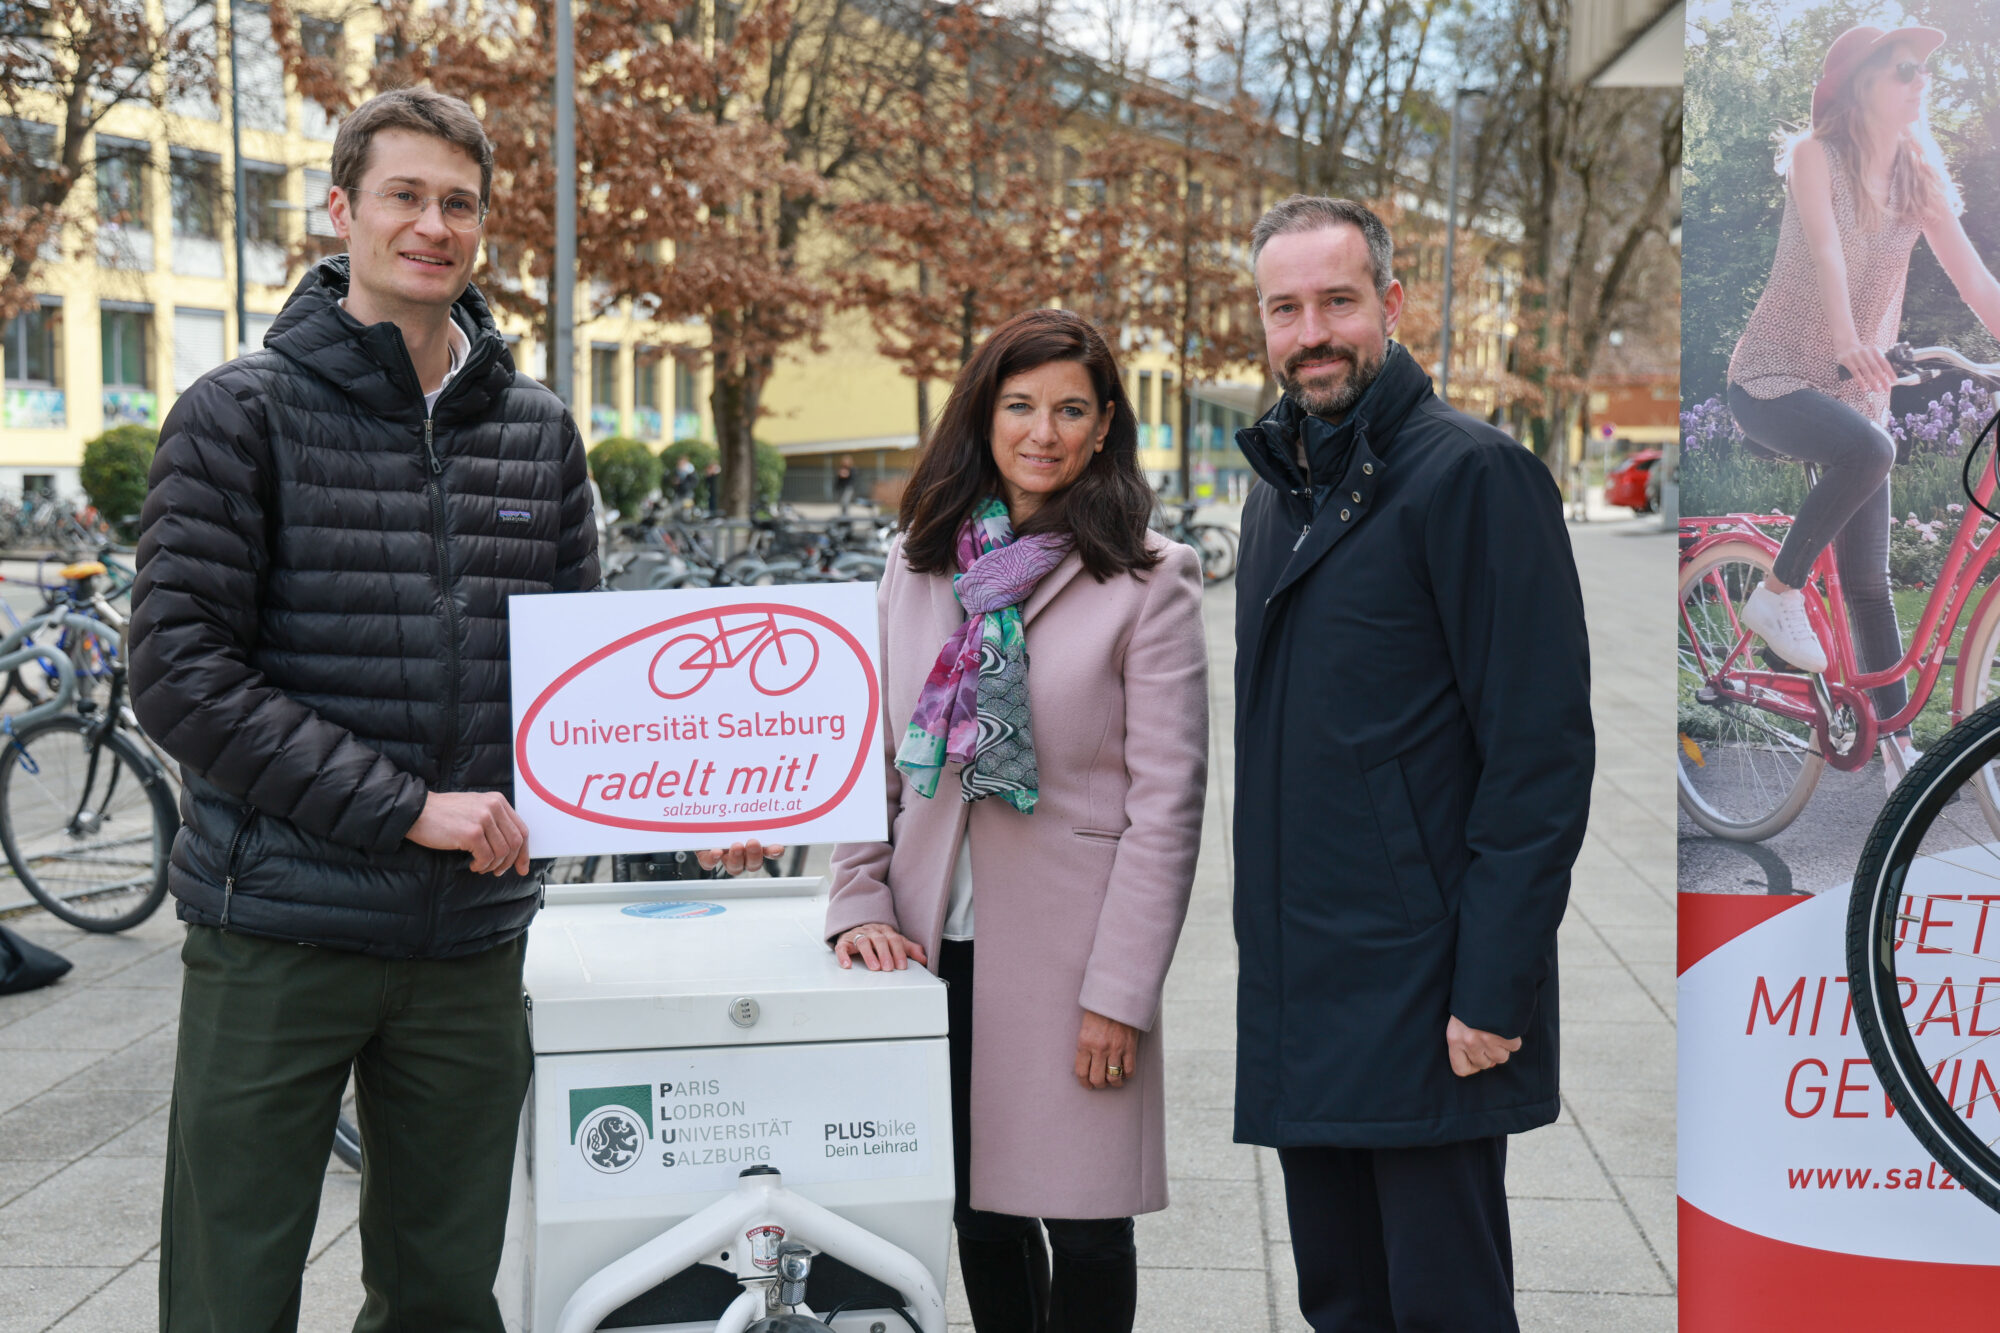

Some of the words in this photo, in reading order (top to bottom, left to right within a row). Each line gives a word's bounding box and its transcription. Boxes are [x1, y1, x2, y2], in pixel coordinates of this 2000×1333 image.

[550, 716, 709, 746] Universität
[718, 711, 845, 740] Salzburg
[576, 760, 716, 808] radelt
[726, 753, 819, 795] mit!
[663, 798, 802, 817] salzburg.radelt.at
[659, 1079, 720, 1098] PARIS
[660, 1101, 745, 1121] LODRON
[661, 1120, 792, 1144] UNIVERSITÄT
[824, 1120, 916, 1141] PLUSbike
[662, 1146, 770, 1168] SALZBURG
[825, 1143, 858, 1157] Dein
[864, 1139, 917, 1155] Leihrad
[1788, 1162, 1966, 1190] www.salz
